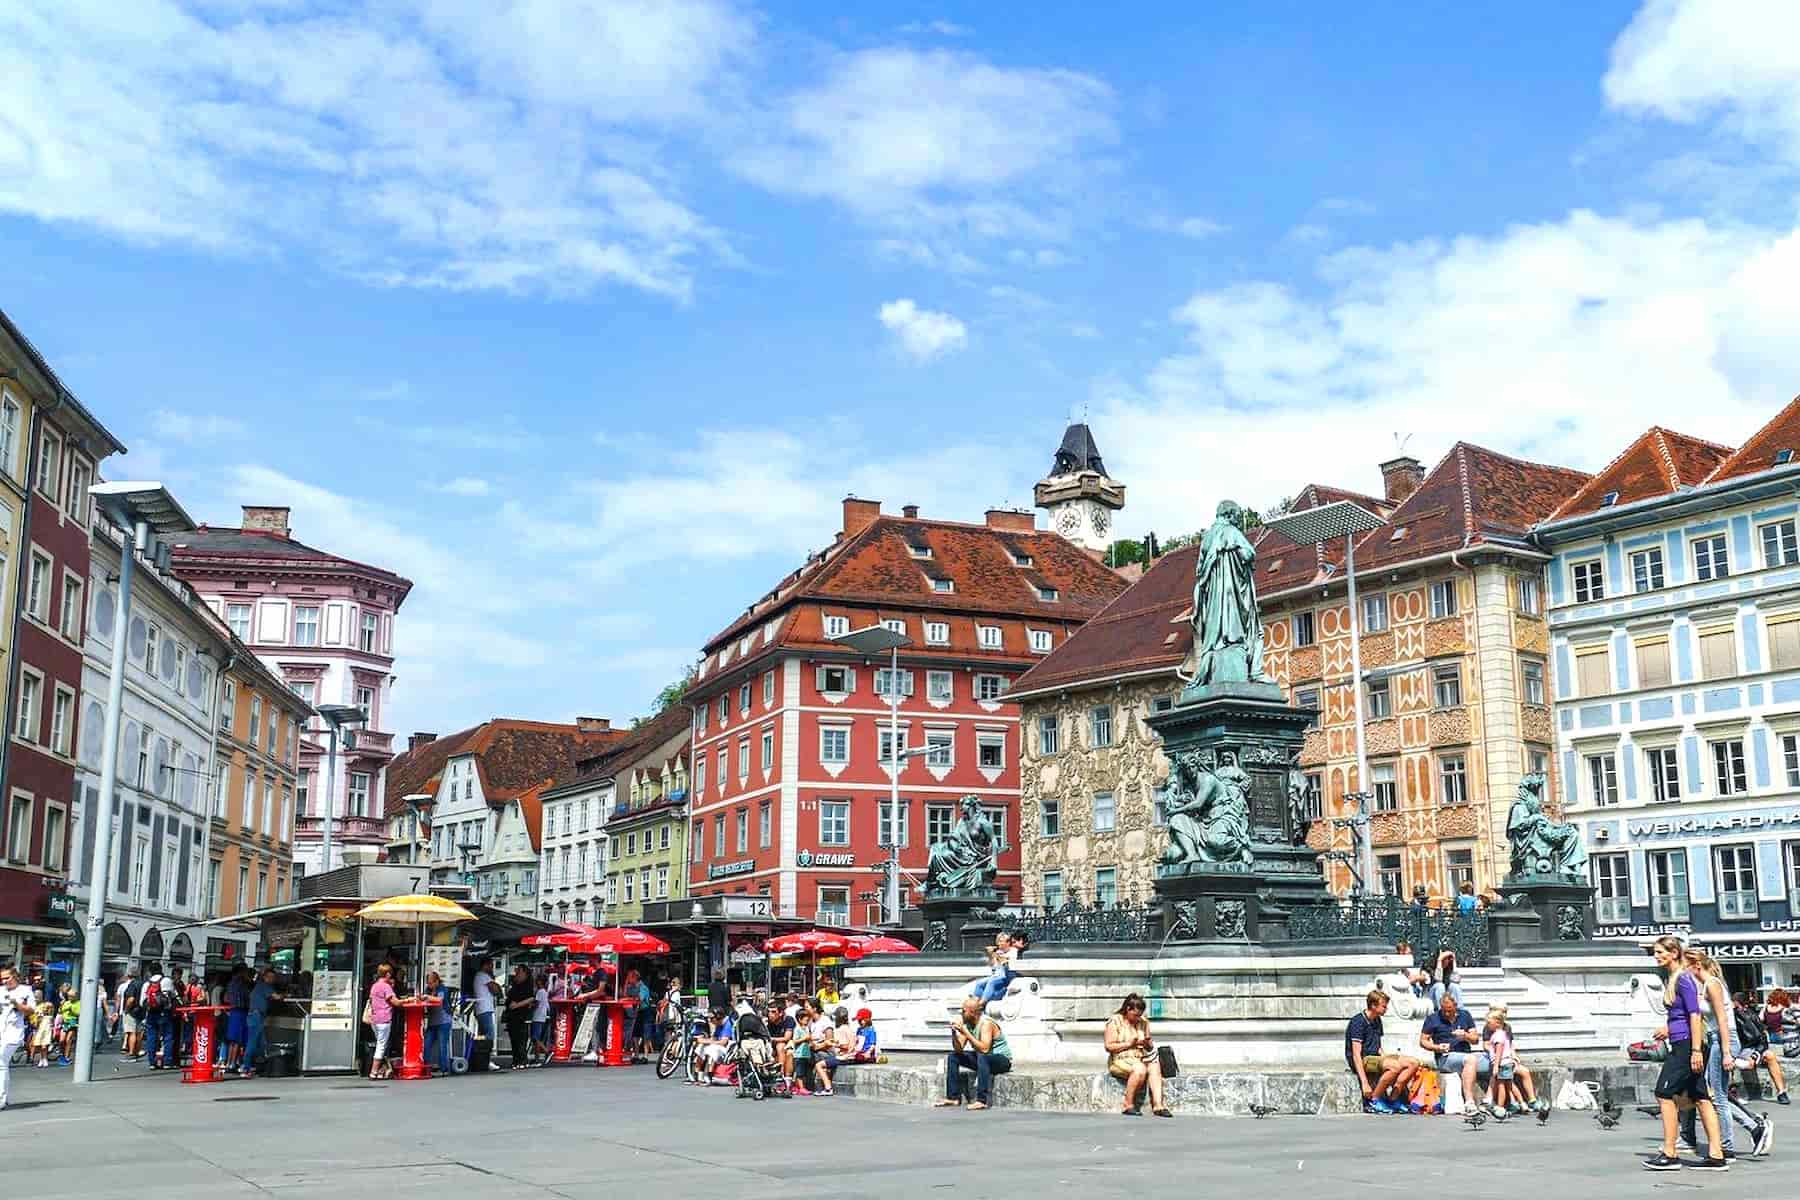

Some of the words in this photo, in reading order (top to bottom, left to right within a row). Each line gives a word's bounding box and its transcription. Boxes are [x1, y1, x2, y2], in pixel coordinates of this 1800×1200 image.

[1629, 814, 1764, 836] WEIKHARD
[815, 853, 856, 866] GRAWE
[410, 877, 421, 893] 7
[750, 902, 766, 915] 12
[1592, 923, 1692, 937] JUWELIER
